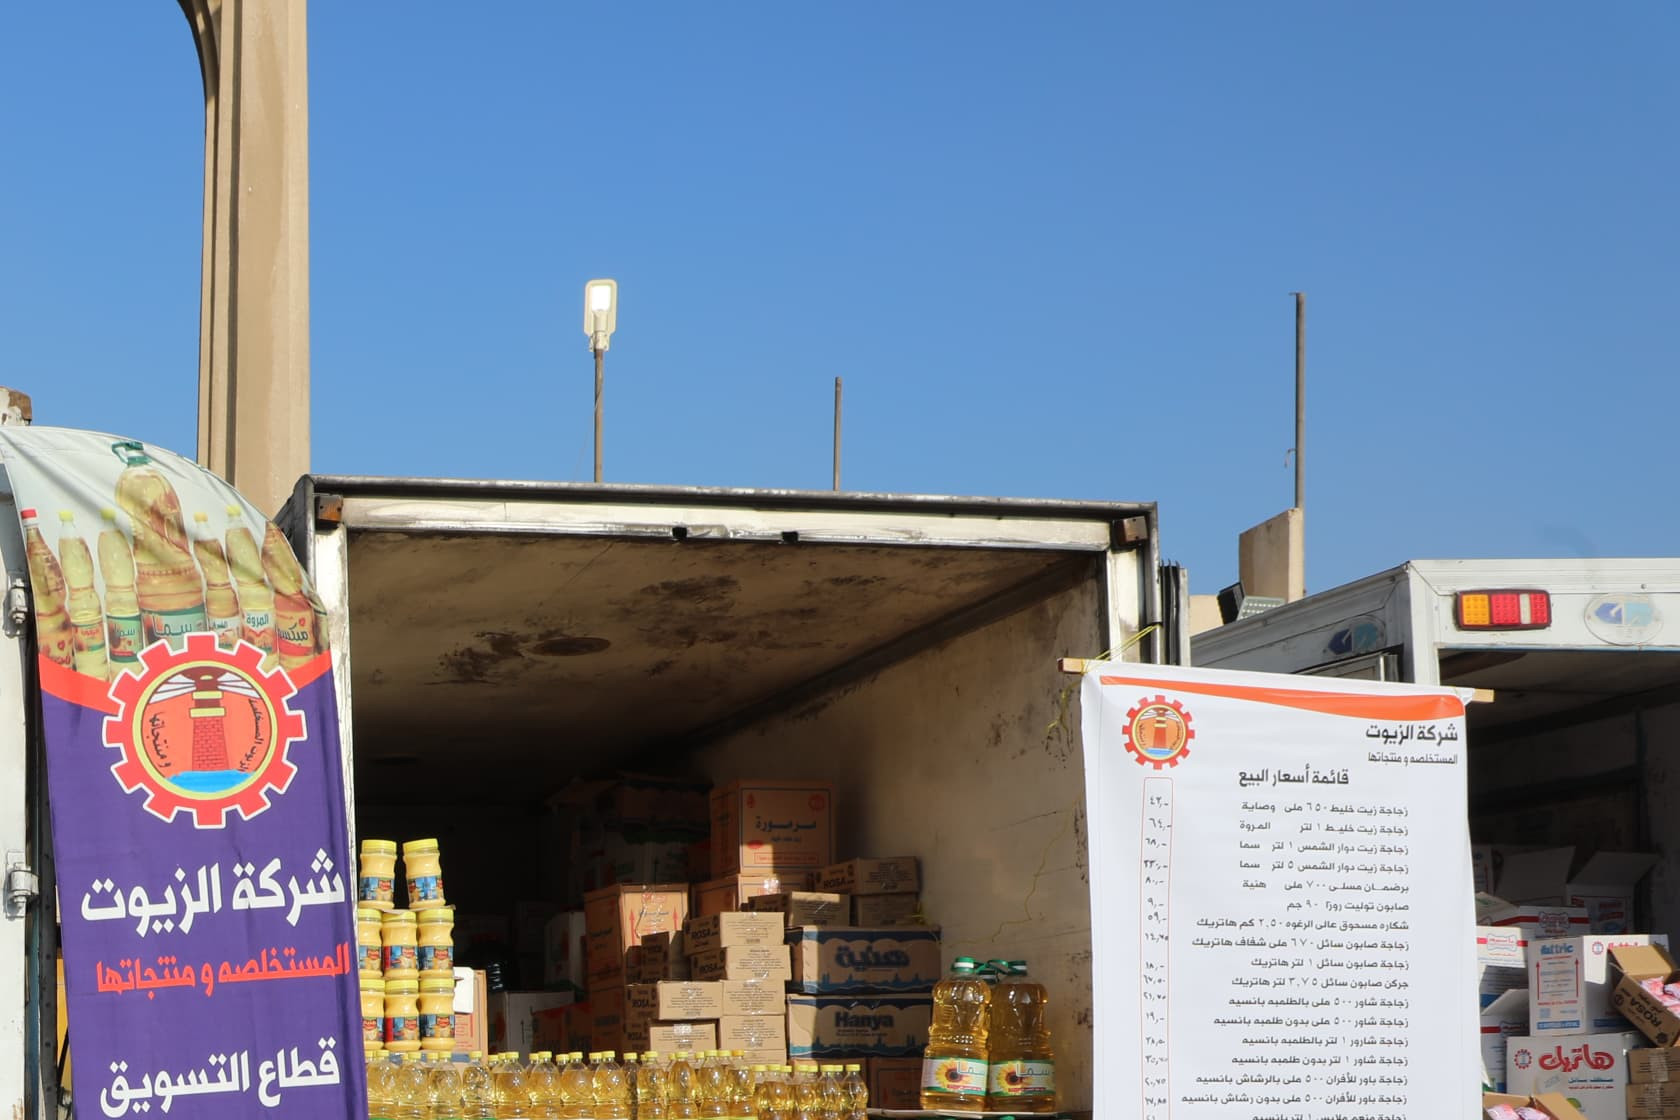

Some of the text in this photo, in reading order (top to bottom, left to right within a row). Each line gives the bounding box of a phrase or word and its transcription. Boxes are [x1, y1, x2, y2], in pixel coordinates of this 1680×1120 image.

[1366, 723, 1458, 746] شركة الزيوت
[1404, 756, 1408, 767] و
[1239, 764, 1349, 787] قائمة أسعار البيع
[1242, 802, 1275, 813] وصاية
[1330, 805, 1354, 814] خليط
[1357, 807, 1377, 816] زيت
[1379, 807, 1408, 817] زجاجة
[1272, 842, 1284, 852] لتر
[1298, 842, 1334, 853] الشمس
[1337, 843, 1355, 854] دوار
[1357, 845, 1377, 854] زيت
[1380, 845, 1408, 855] زجاجة
[81, 847, 346, 938] شركة الزيوت
[1197, 919, 1237, 928] هاتريك
[95, 942, 350, 1000] المستخلصه و منتجاتها
[835, 1012, 894, 1029] Hanya
[1539, 1044, 1615, 1072] هاتريك
[99, 1036, 340, 1119] قطاع التسويق
